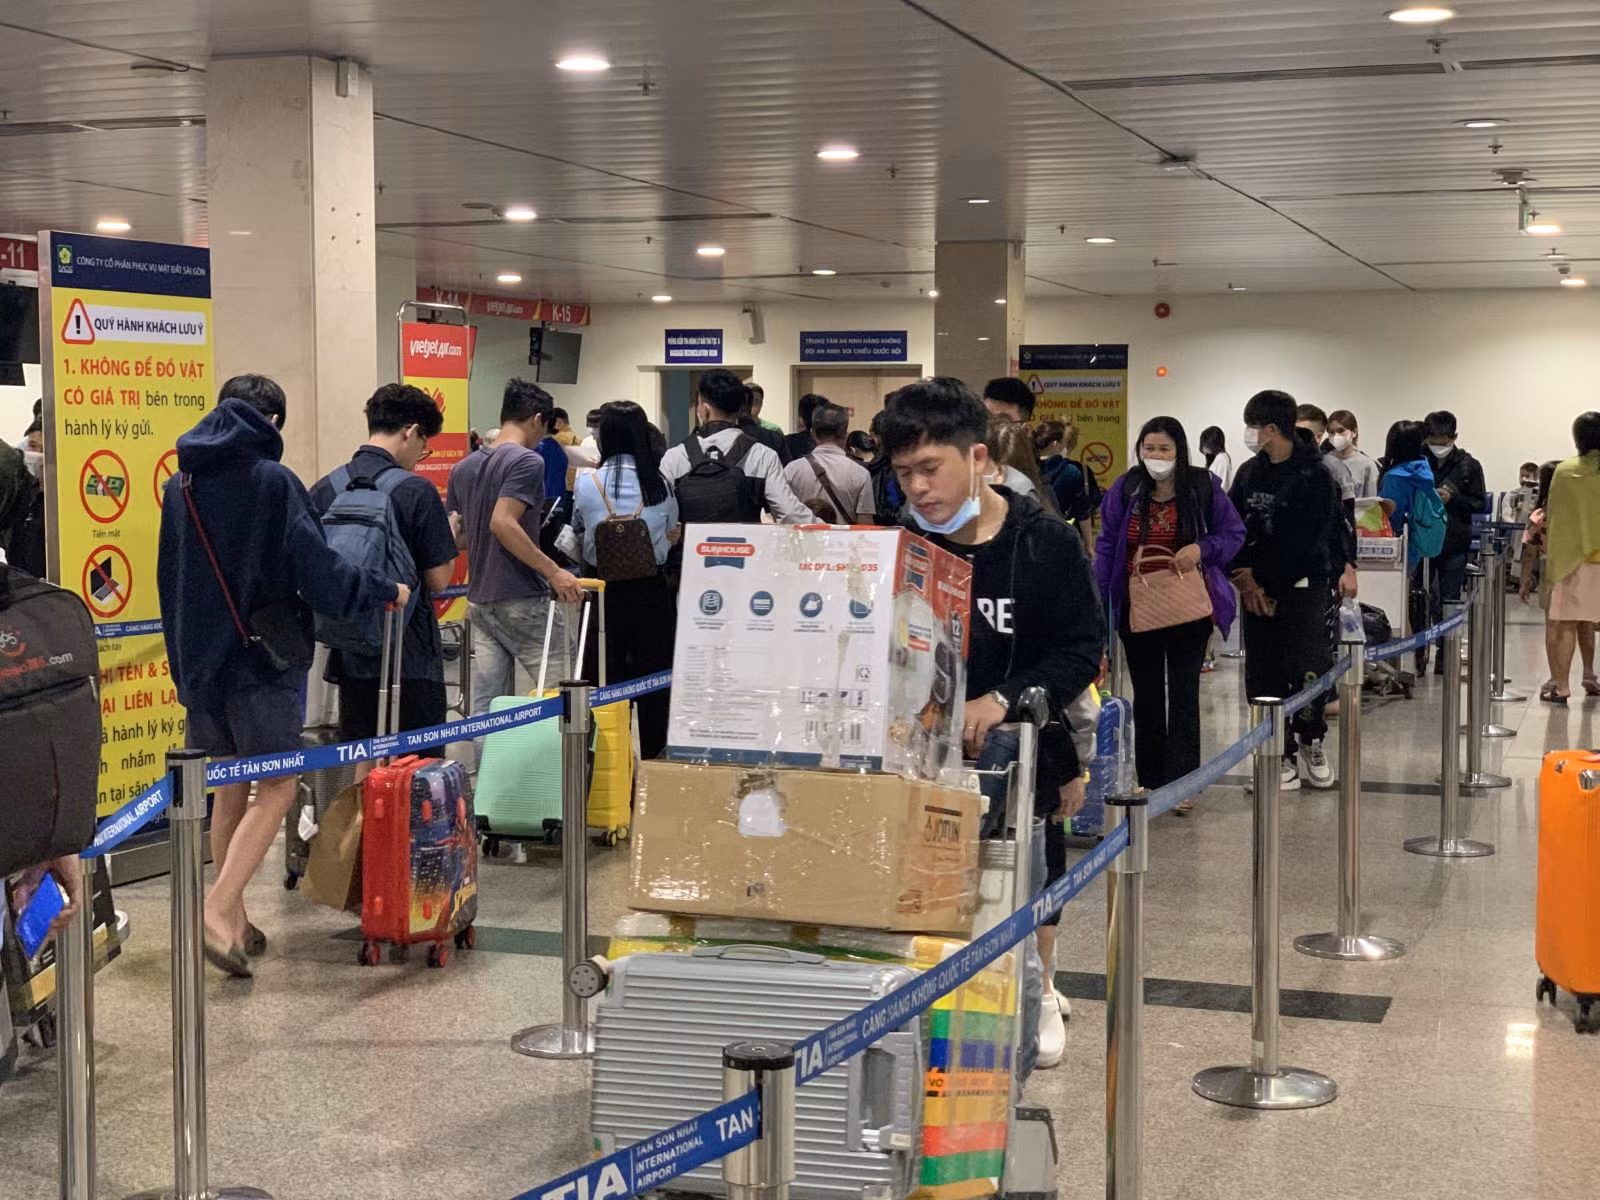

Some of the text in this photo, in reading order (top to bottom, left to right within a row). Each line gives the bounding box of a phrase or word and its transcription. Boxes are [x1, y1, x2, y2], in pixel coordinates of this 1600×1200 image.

[94, 317, 114, 331] QUÝ
[117, 317, 143, 332] HÀNH
[146, 319, 176, 334] KHÁCH
[552, 304, 571, 322] K-15
[63, 359, 75, 374] 1.
[81, 356, 130, 376] KHÔNG
[179, 361, 204, 382] VẬT
[63, 385, 205, 411] CÓ GIÁ TRỊ bên trong
[64, 418, 154, 440] hành lý ký gửi.
[100, 660, 169, 684] HI TÊN & S
[102, 688, 177, 718] ẠI LIÊN LẠ
[113, 723, 143, 742] hành
[147, 719, 158, 740] lý
[161, 717, 174, 737] ký
[407, 706, 542, 745] TAN SON NHAT INTERNATIONAL AIRPORT
[208, 751, 305, 780] UỐC TẾ TÂN SƠN NHẤT
[337, 743, 367, 762] TIA
[111, 784, 125, 804] tại
[134, 790, 163, 819] AIRPORT
[1032, 892, 1053, 926] TIA
[716, 1105, 754, 1141] TAN
[636, 1120, 698, 1157] TAN SON NHAT
[635, 1135, 704, 1174] INTERNATIONAL
[637, 1163, 677, 1189] AIRPORT
